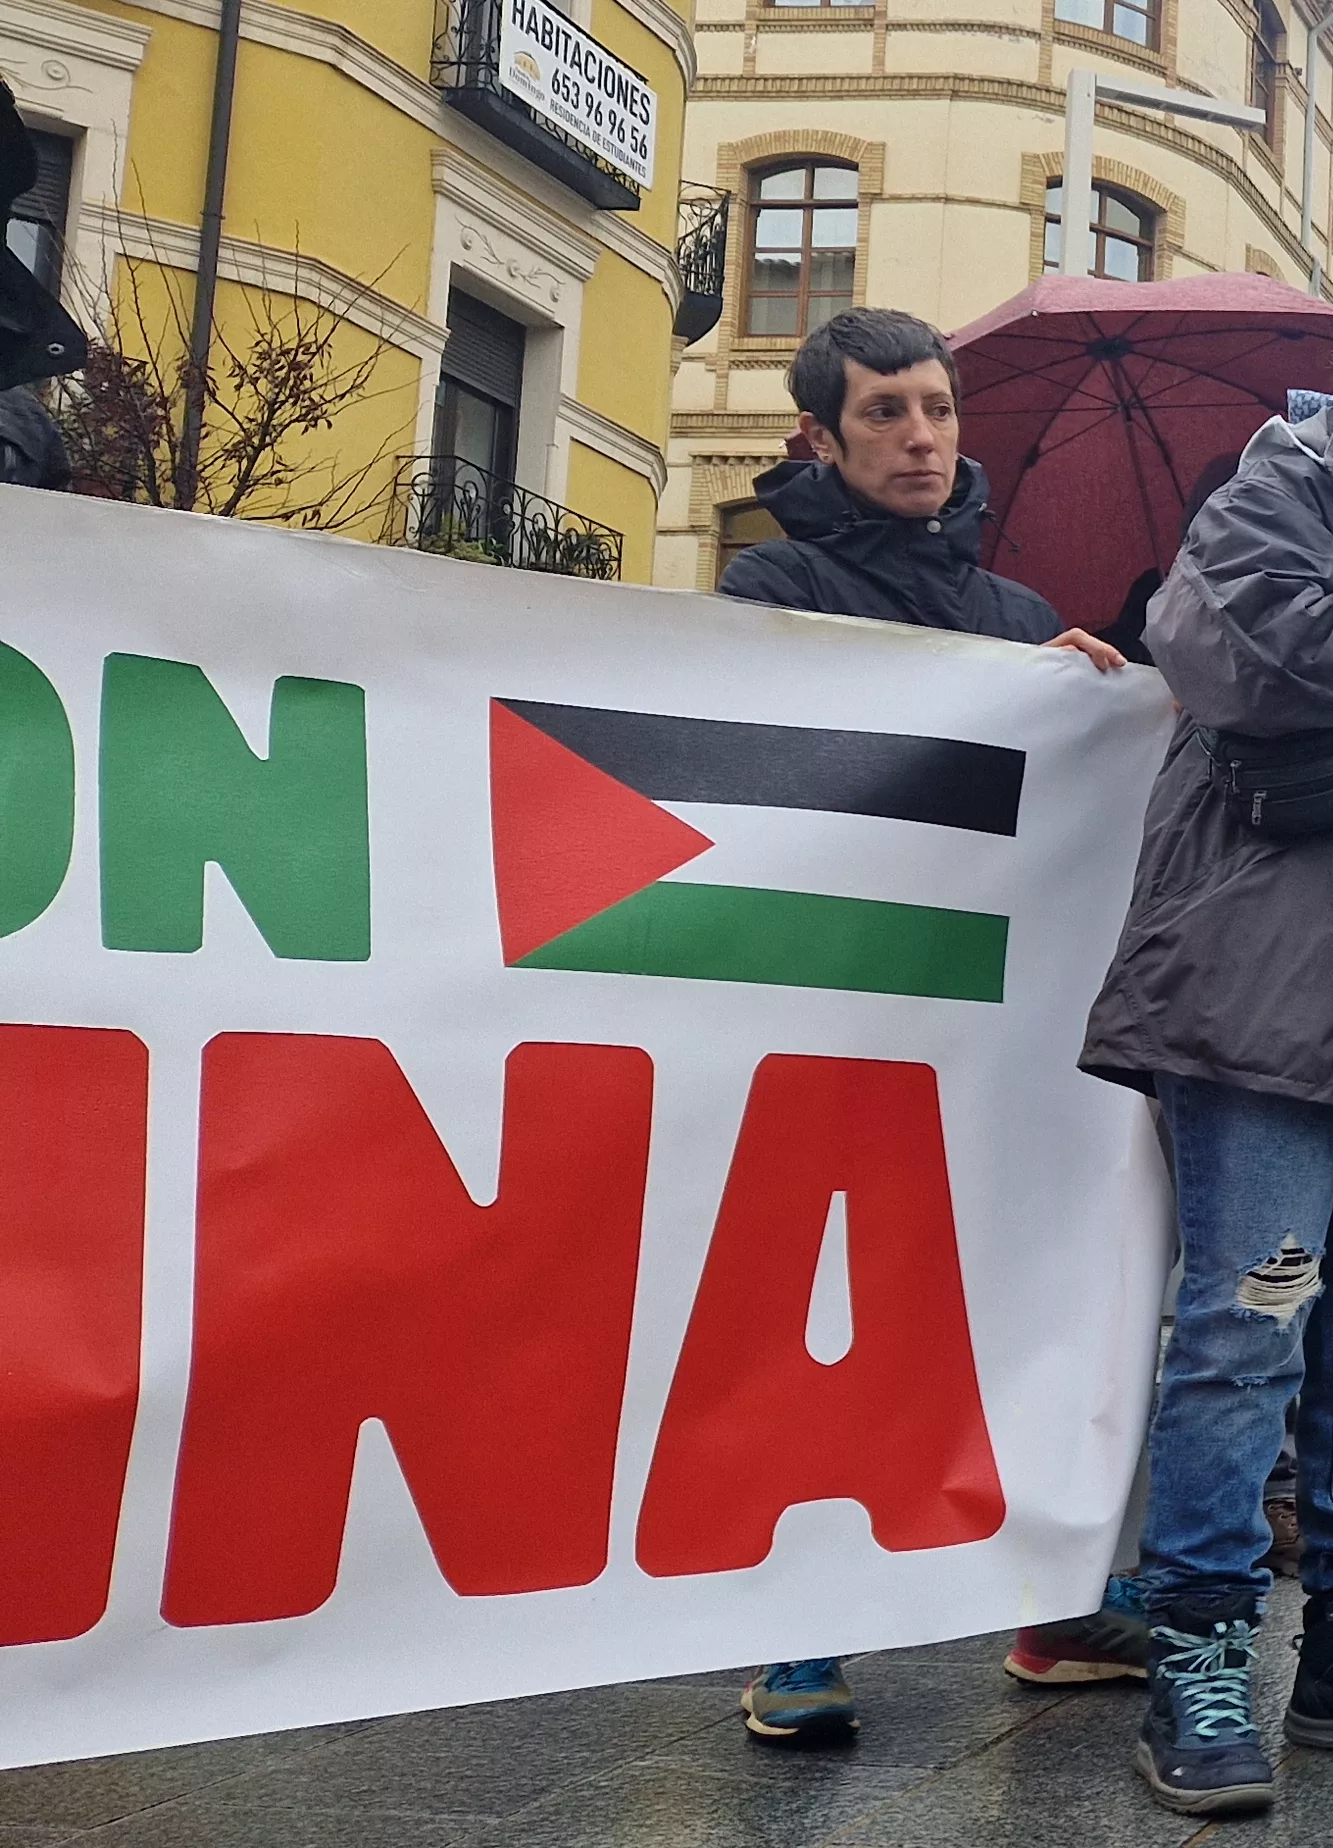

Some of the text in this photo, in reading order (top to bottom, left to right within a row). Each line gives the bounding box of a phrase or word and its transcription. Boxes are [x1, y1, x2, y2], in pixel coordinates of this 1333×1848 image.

[511, 0, 651, 126] HABITACIONES
[550, 98, 647, 178] RESIDENCIA DE ESTUDIANTES
[551, 67, 580, 110] 653
[585, 91, 603, 127] 96
[608, 108, 625, 144] 96
[630, 125, 648, 160] 56
